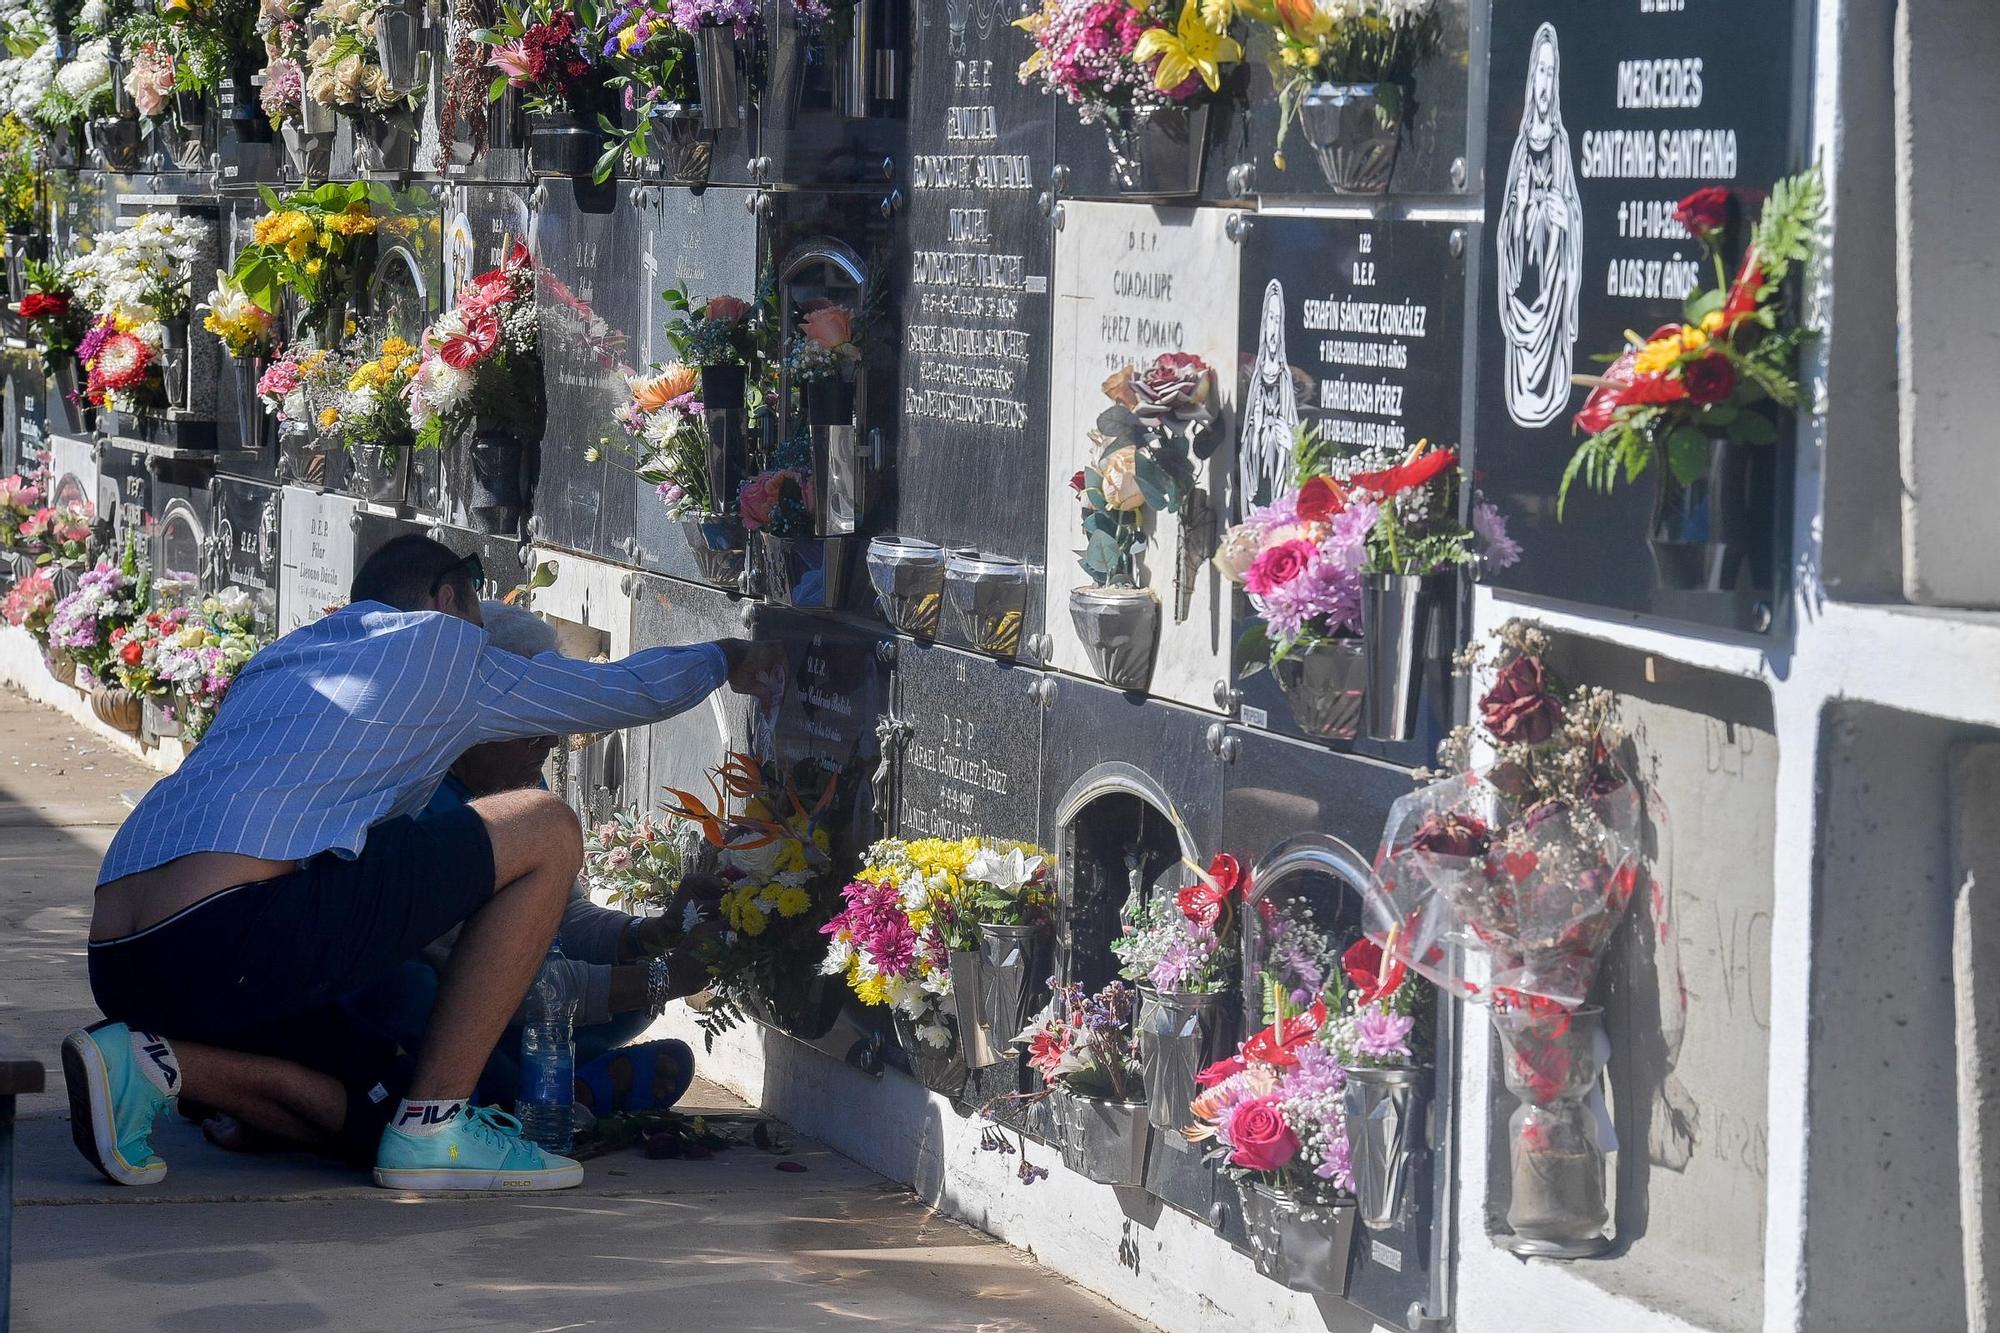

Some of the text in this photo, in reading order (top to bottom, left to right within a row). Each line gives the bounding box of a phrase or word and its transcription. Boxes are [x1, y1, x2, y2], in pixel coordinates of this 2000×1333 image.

[1617, 57, 1703, 109] MERCEDES
[1581, 129, 1737, 179] SANTANA SANTANA
[1113, 270, 1173, 303] GUADALUPE
[1607, 259, 1618, 296] A
[1619, 259, 1644, 297] LOS
[1662, 251, 1699, 300] AÑOS
[1303, 293, 1427, 337] SERAFÍN SÁNCHEZ GONZÁLEZ
[1321, 373, 1403, 416] MARÍA BOSA PÉREZ
[938, 746, 979, 786] GONZALEZ
[981, 759, 1007, 795] PEREZ
[399, 1103, 462, 1126] FILA
